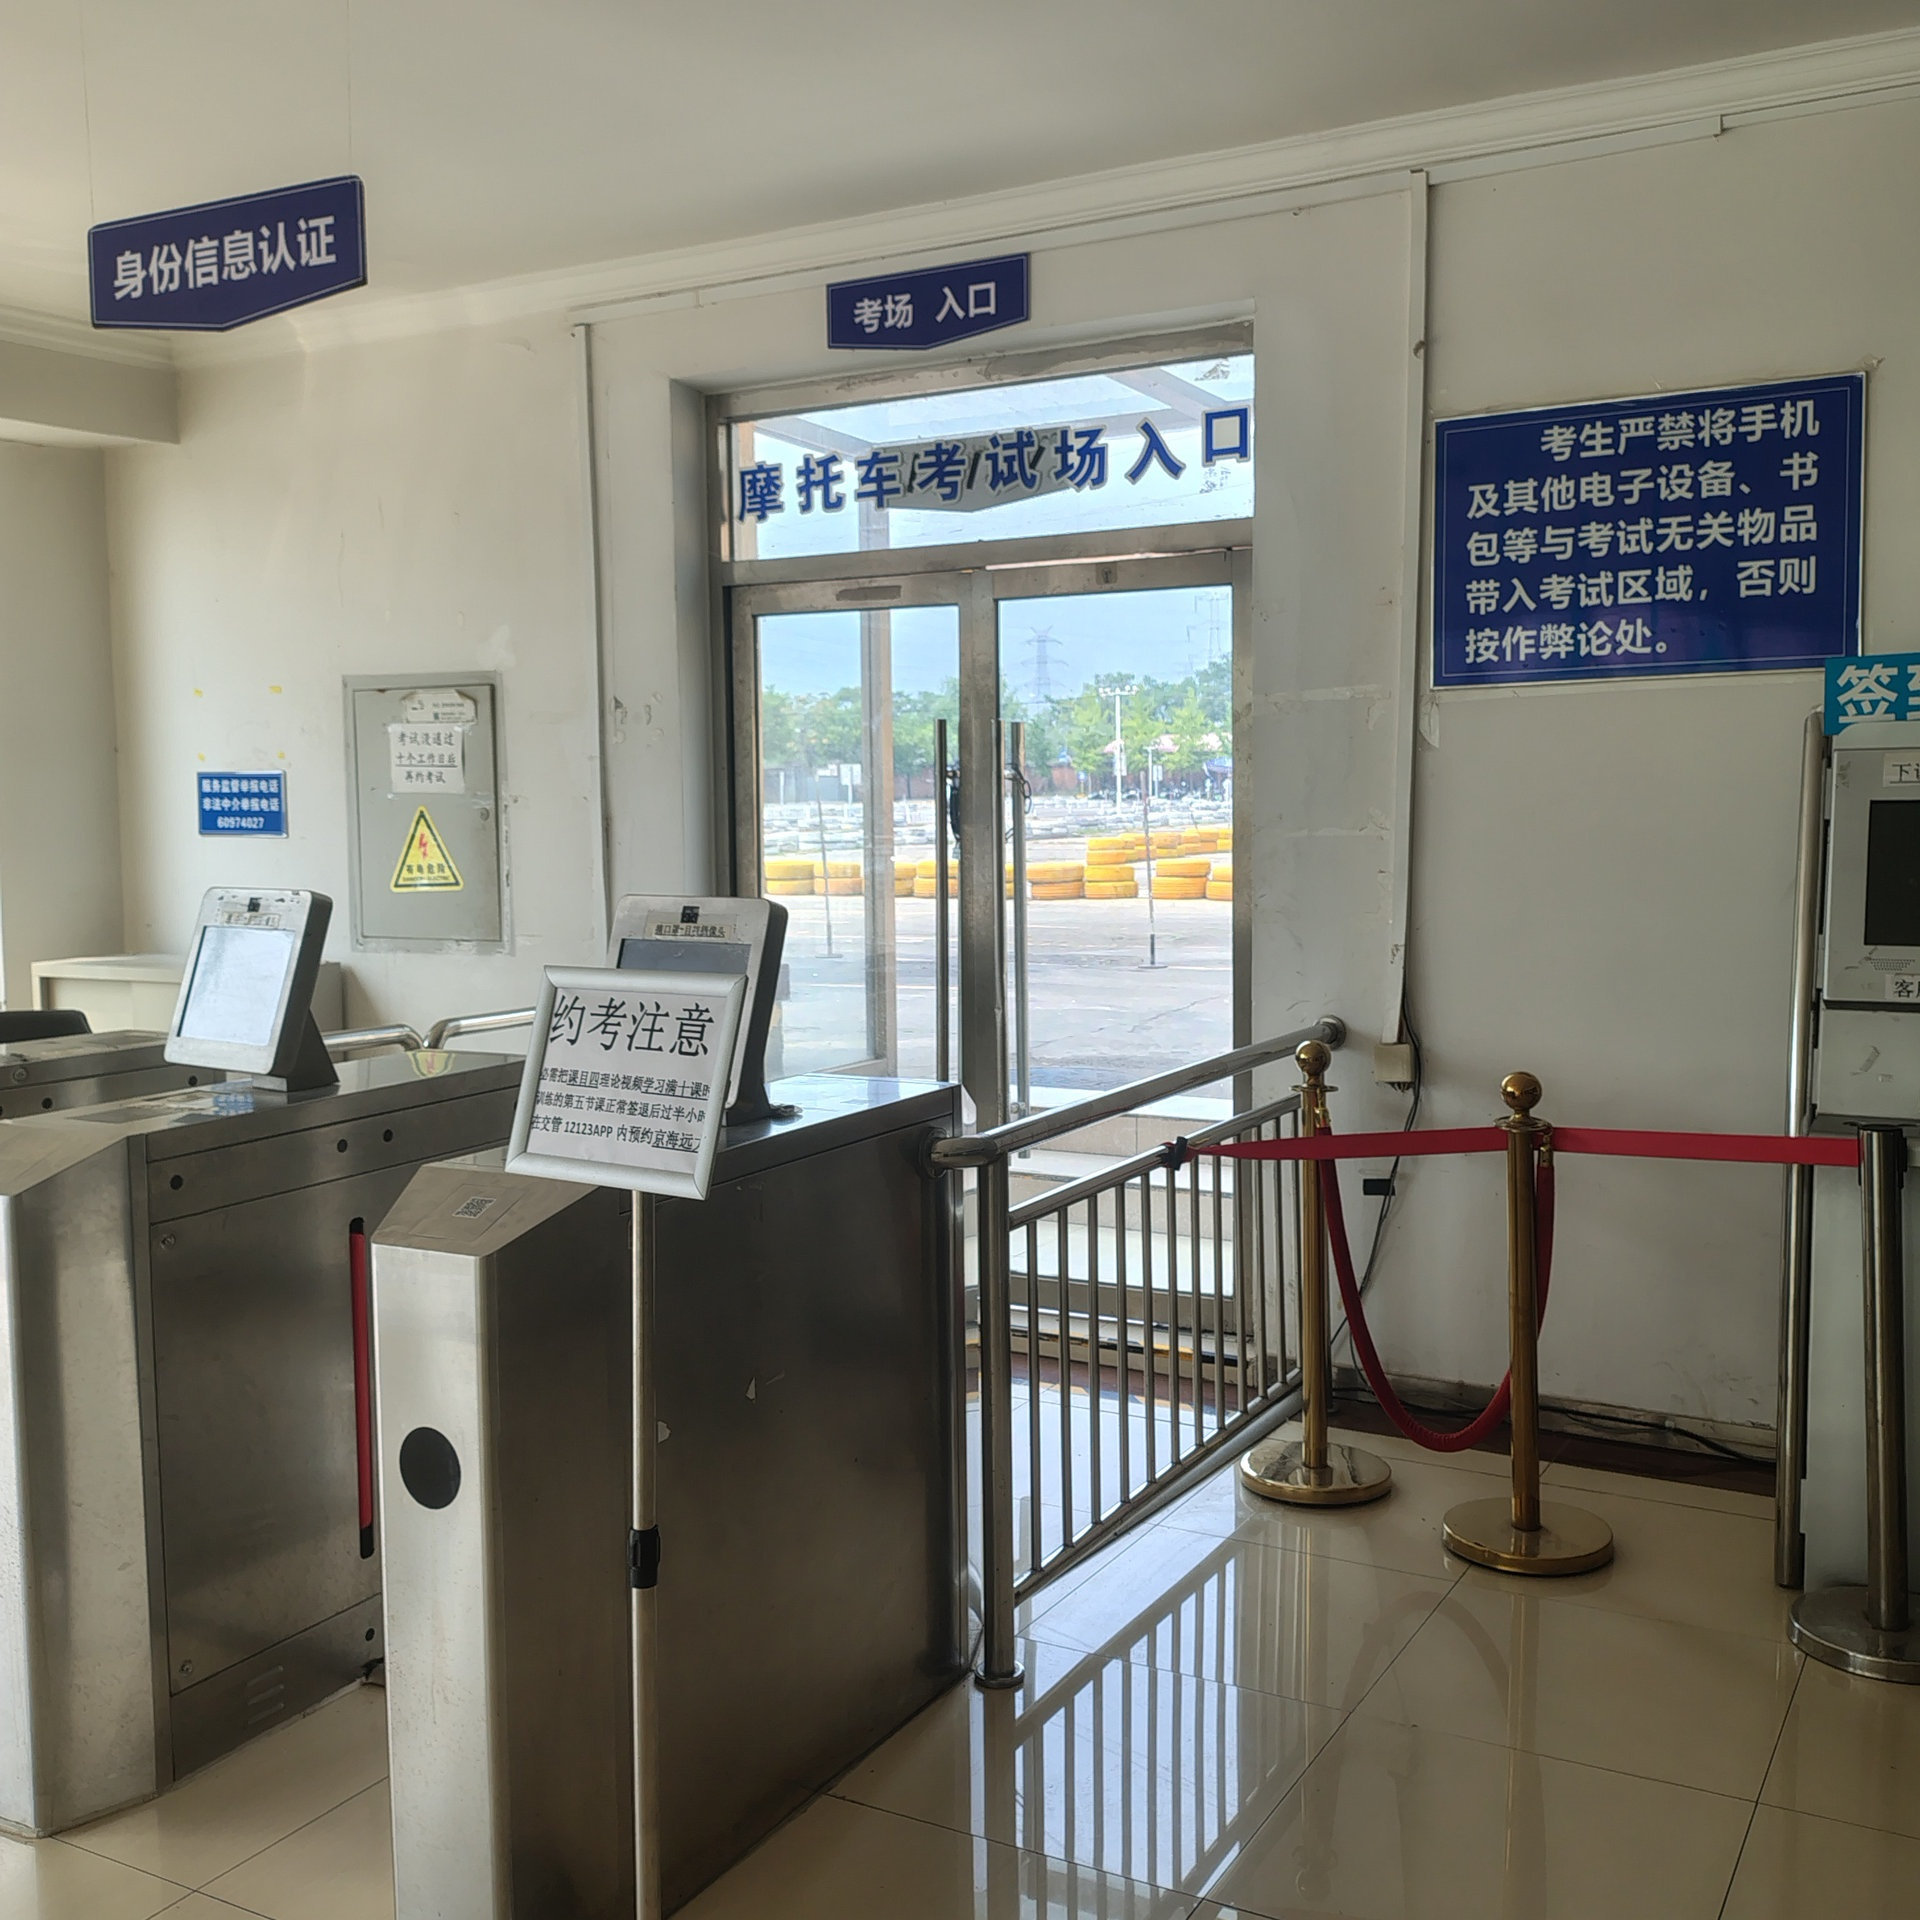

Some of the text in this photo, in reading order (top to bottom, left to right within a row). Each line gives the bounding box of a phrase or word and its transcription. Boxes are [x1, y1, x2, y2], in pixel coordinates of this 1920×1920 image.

[113, 215, 337, 300] 身份信息认证
[853, 281, 997, 333] 考场 入口
[1540, 399, 1821, 463] 考生严禁将手机
[736, 404, 1252, 523] 摩托车考试场入口
[1465, 503, 1818, 568] 包等与考试无关物品
[1464, 617, 1669, 664] 按作弊论处。
[1836, 663, 1920, 724] 签
[1890, 762, 1920, 782] 下
[1893, 978, 1920, 999] 客
[550, 993, 715, 1057] 约考注意
[564, 1120, 613, 1138] 12123APP
